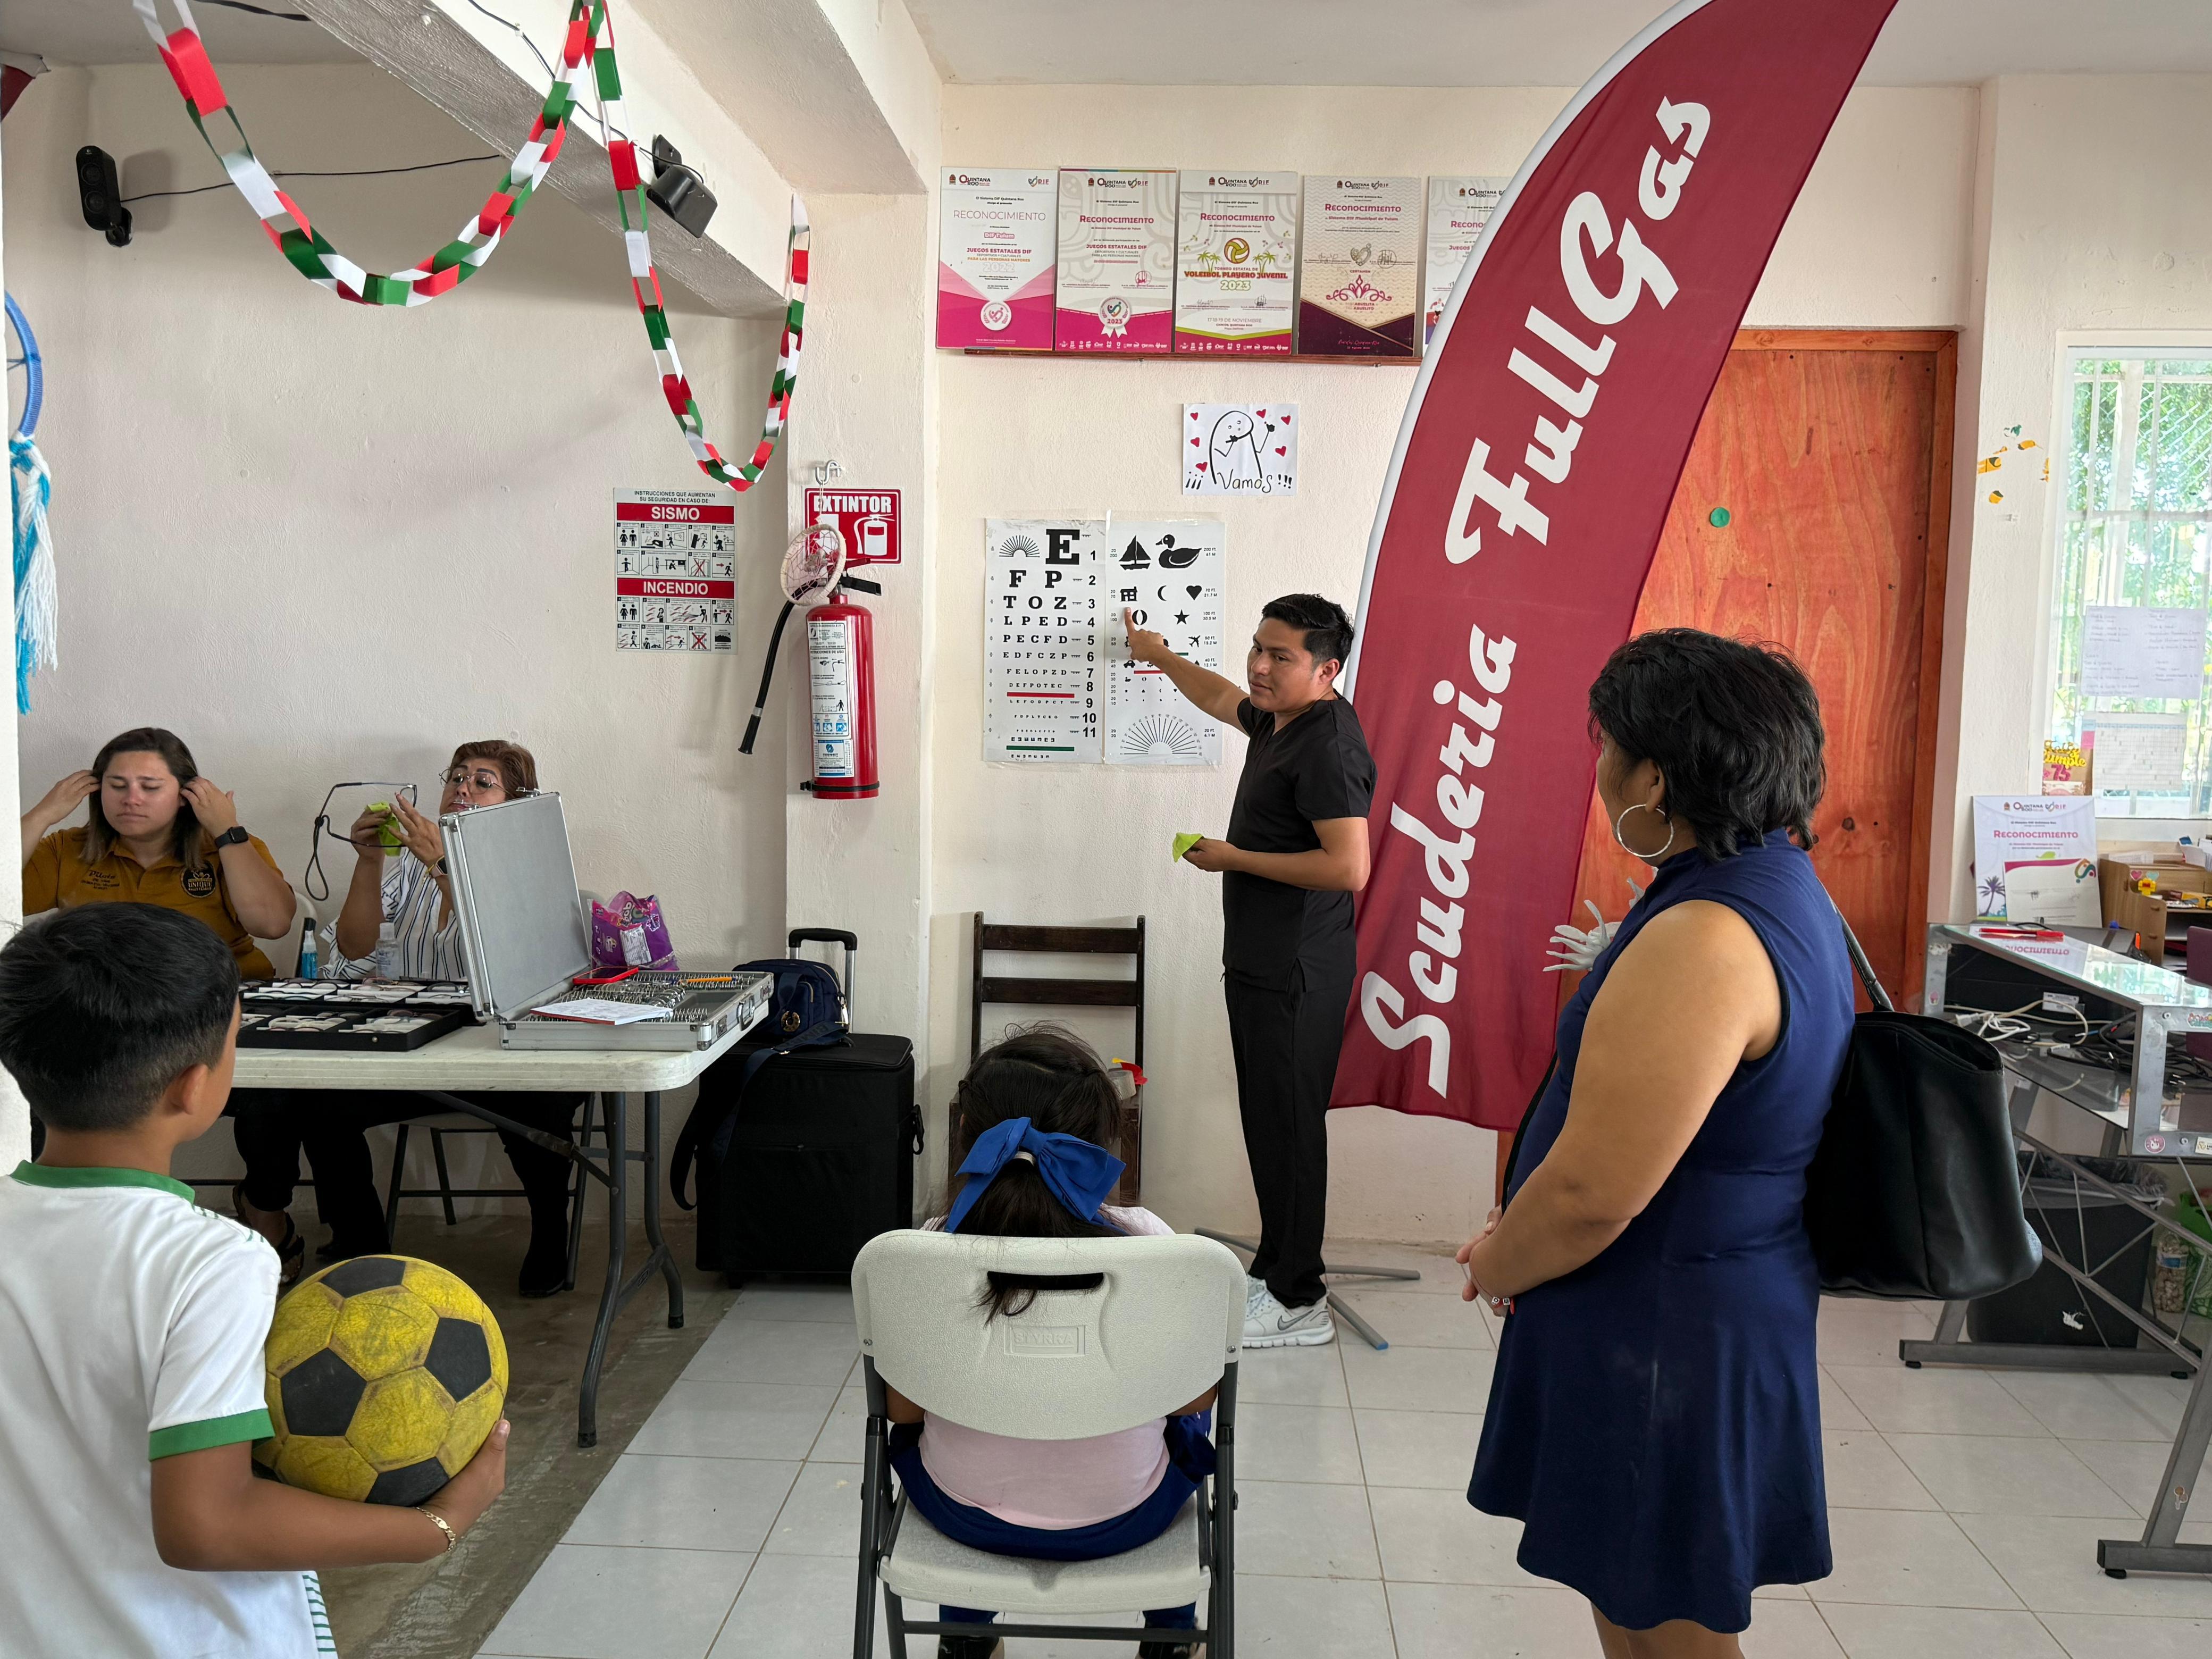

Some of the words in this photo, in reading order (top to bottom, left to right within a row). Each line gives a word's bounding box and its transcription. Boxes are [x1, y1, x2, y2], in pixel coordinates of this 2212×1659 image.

[953, 210, 1046, 221] RECONOCIMIENTO
[983, 262, 1016, 273] 2022
[1220, 280, 1251, 291] 2023
[814, 495, 892, 513] EXTINTOR
[651, 506, 700, 521] SISMO
[1045, 529, 1080, 565] E
[1090, 550, 1096, 560] 1
[1088, 575, 1096, 585] 2
[643, 581, 709, 596] INCENDIO
[1088, 599, 1095, 609] 3
[1087, 617, 1095, 627] 4
[1087, 635, 1095, 646] 5
[1087, 651, 1094, 661] 6
[1086, 668, 1094, 678] 7
[1086, 681, 1093, 692] 8
[1086, 698, 1093, 708] 9
[1082, 713, 1096, 723] 10
[1083, 727, 1096, 738] 11
[2051, 764, 2071, 782] 75
[1361, 621, 1517, 1099] Scuderia
[1013, 1333, 1074, 1345] STYRKA
